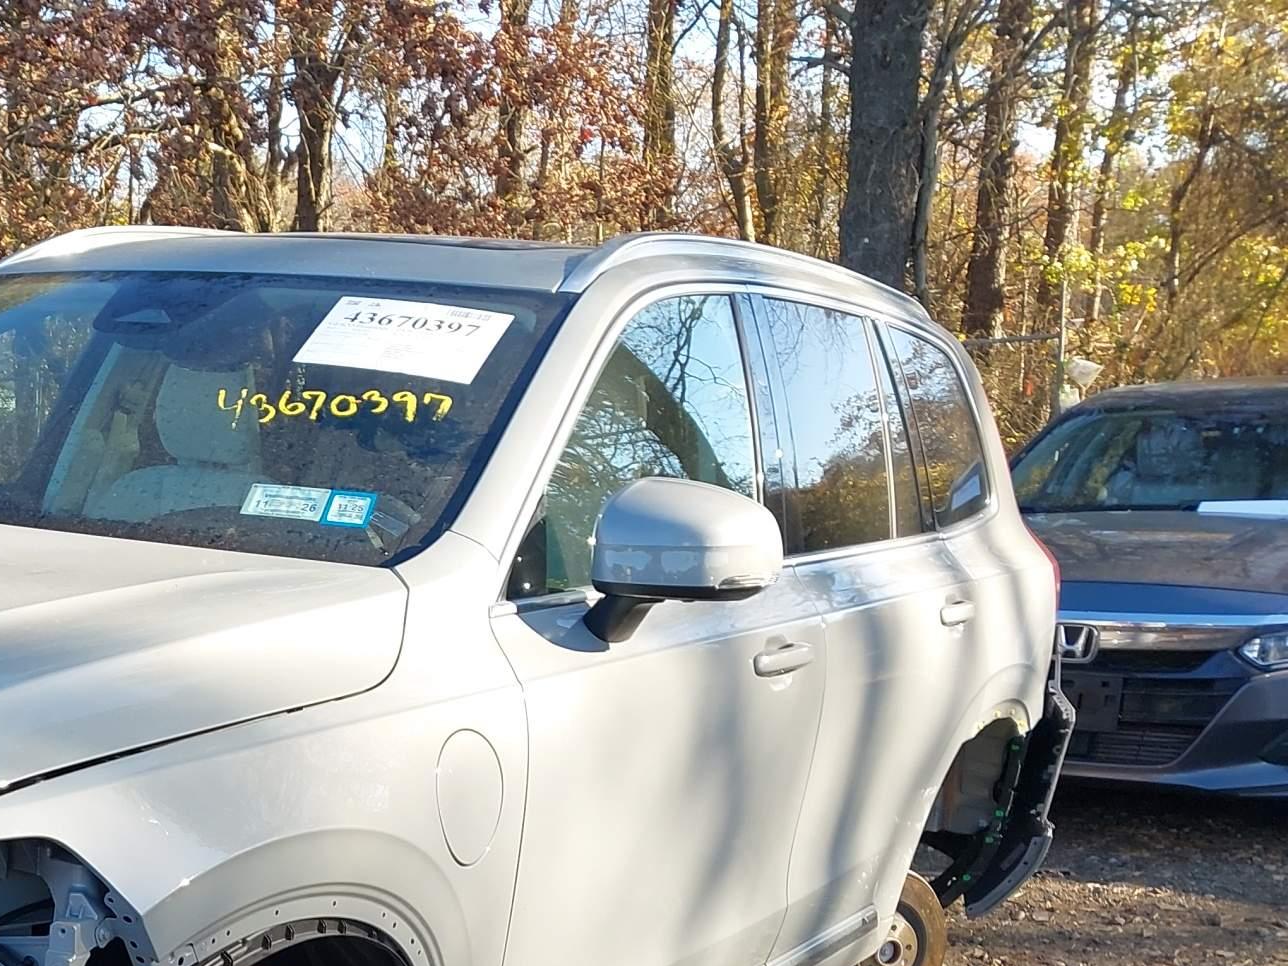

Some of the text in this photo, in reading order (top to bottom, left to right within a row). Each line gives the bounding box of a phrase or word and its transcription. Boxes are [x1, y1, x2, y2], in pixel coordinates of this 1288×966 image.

[344, 311, 481, 337] 43670397
[218, 388, 453, 431] 43670397
[301, 503, 318, 513] 26
